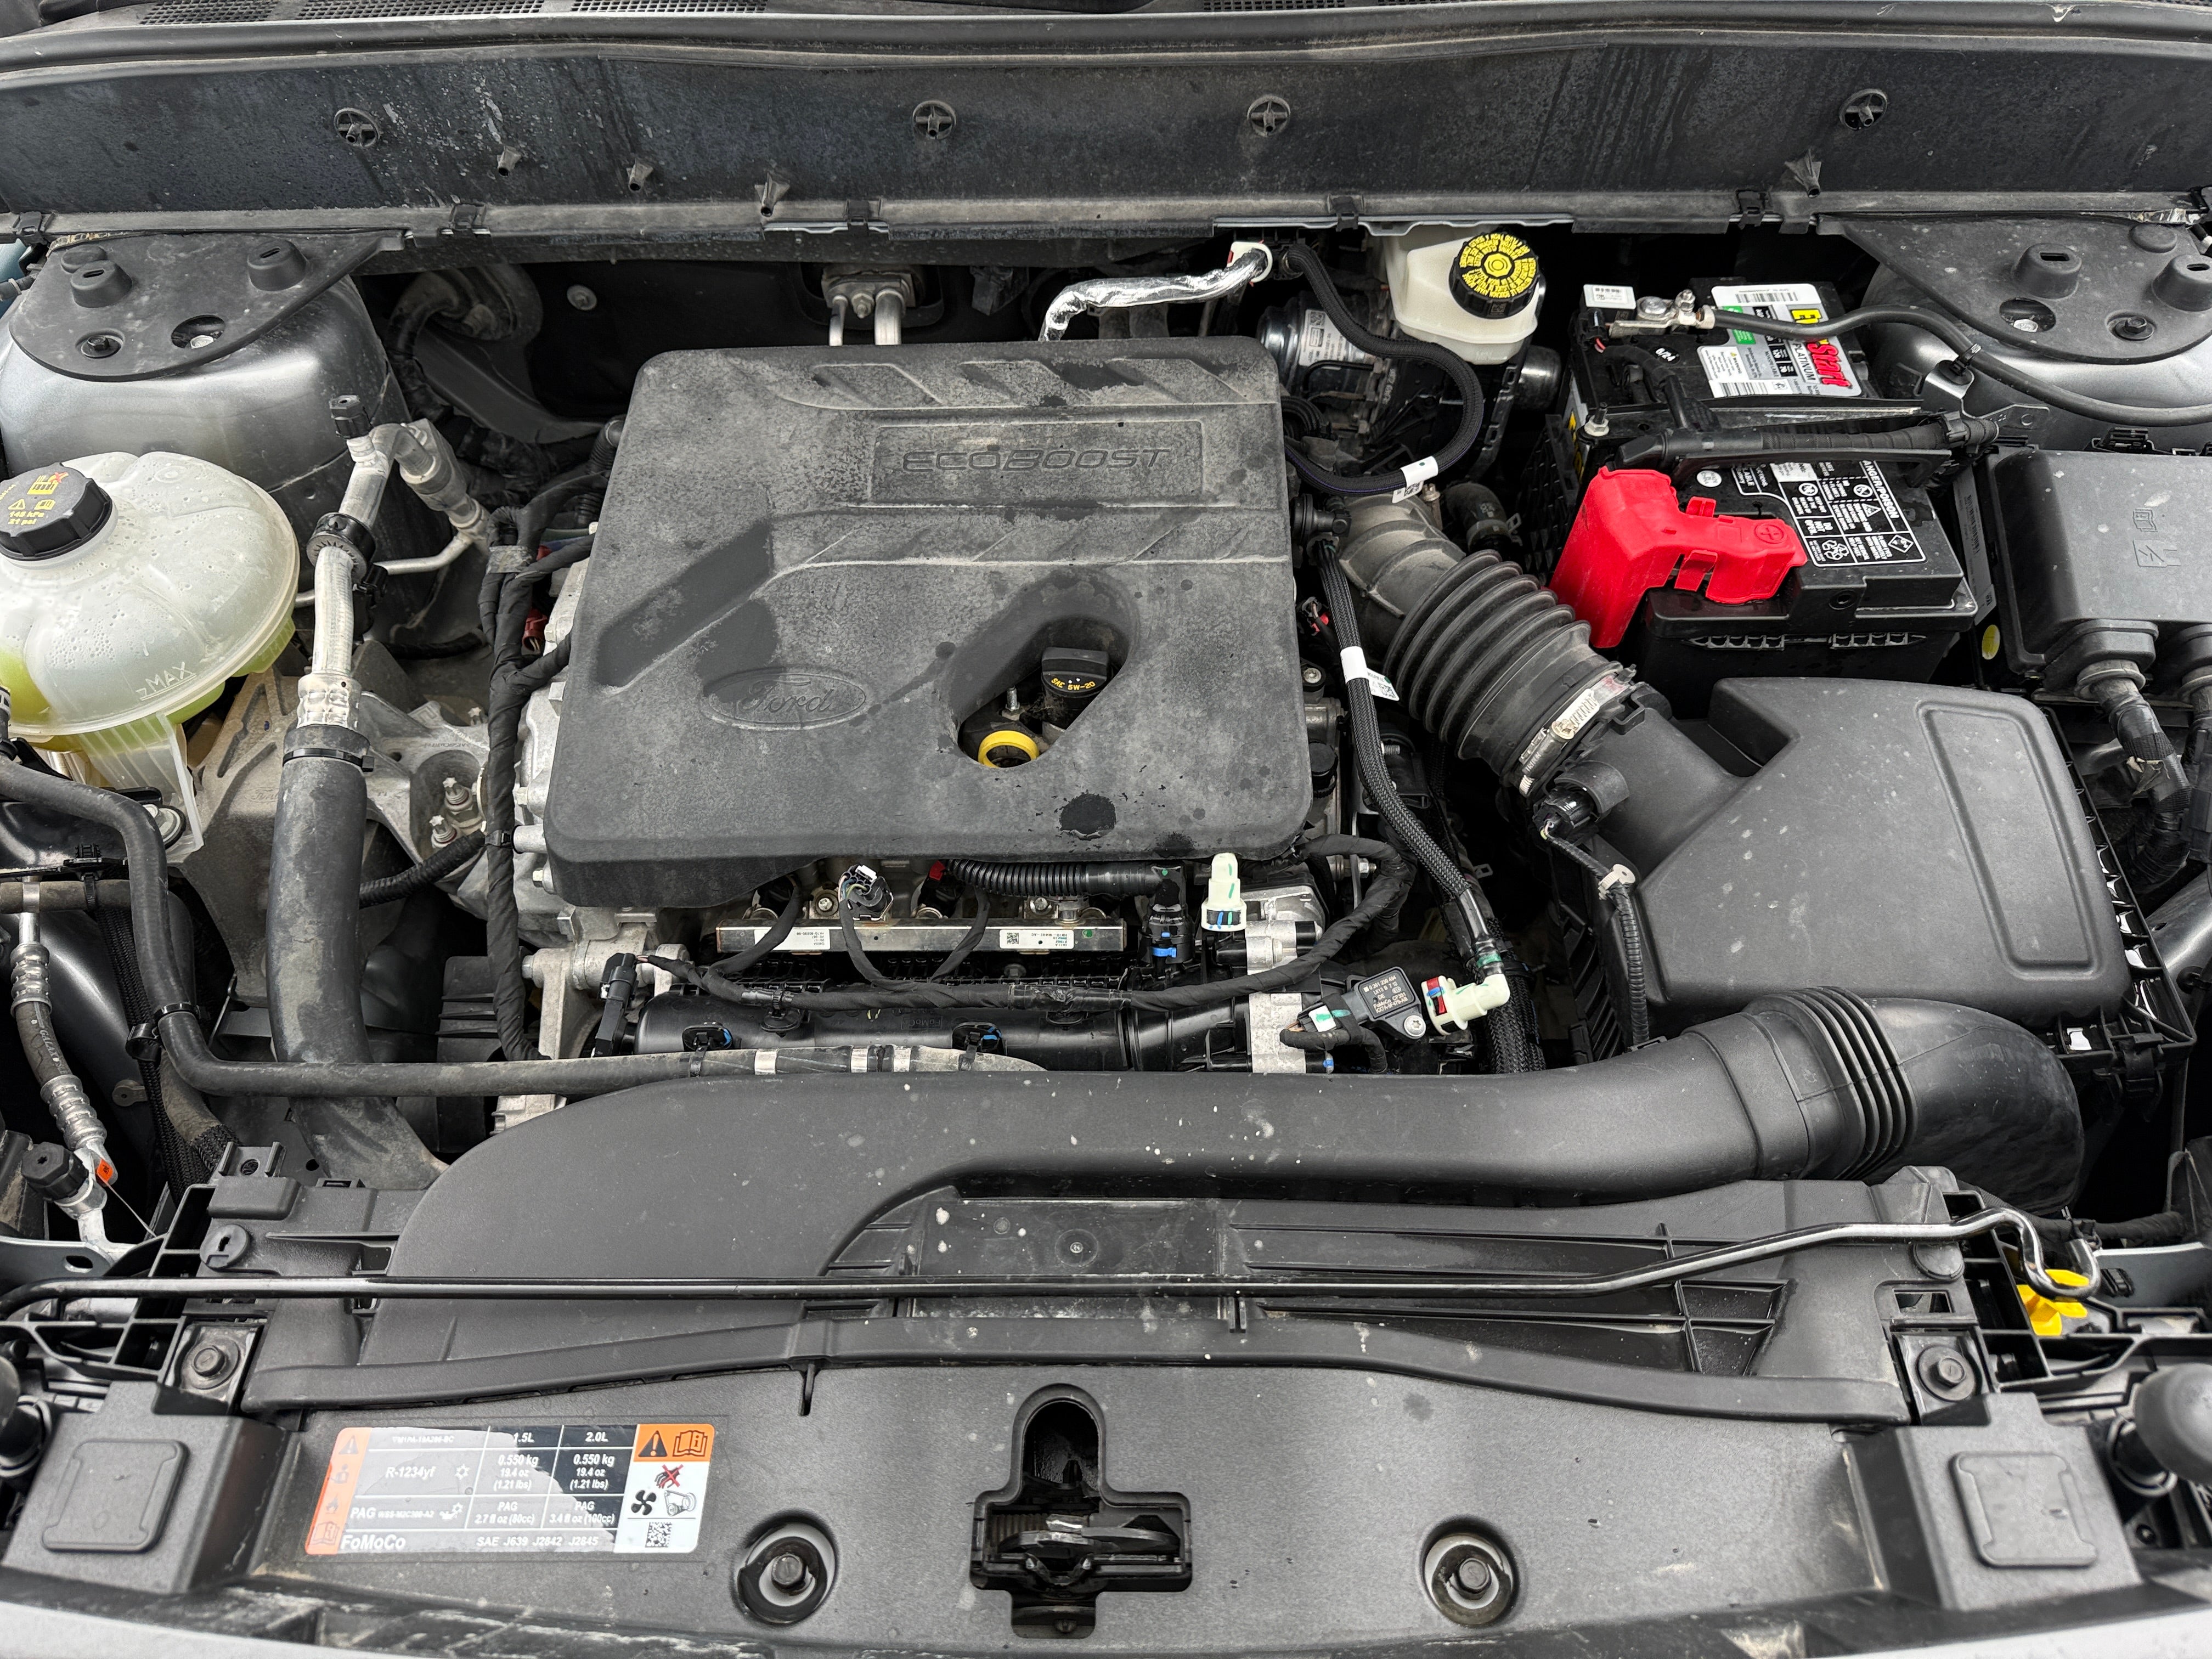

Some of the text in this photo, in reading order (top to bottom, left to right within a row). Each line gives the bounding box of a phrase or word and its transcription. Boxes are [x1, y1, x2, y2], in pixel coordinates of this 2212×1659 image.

[1791, 309, 1851, 386] EStart
[1793, 343, 1816, 381] PLATINUM
[1863, 460, 1900, 518] ANGER/POISON
[1814, 521, 1826, 533] NOT
[1822, 522, 1833, 531] DO
[145, 661, 193, 692] MAX
[1051, 678, 1096, 691] SAE 5W-20
[737, 679, 832, 713] Ford
[1373, 998, 1392, 1009] FoMoCo
[513, 1432, 535, 1442] 1.5L
[585, 1432, 609, 1442] 2.0L
[498, 1454, 539, 1468] 0.550 kg
[573, 1453, 615, 1468] 0.550 kg
[385, 1466, 437, 1480] R-1234yf
[500, 1468, 518, 1477] 19.4
[576, 1468, 594, 1476] 19.4
[493, 1479, 532, 1491] (1.21 lbs)
[569, 1479, 609, 1491] (1.21 lbs)
[497, 1502, 518, 1511] PAG
[575, 1501, 595, 1510] PAG
[350, 1507, 376, 1519] PAG
[474, 1514, 488, 1523] 2.7
[489, 1514, 496, 1523] fl
[549, 1513, 563, 1523] 3.4
[563, 1513, 571, 1523] fl
[583, 1513, 616, 1525] (100cc)
[340, 1534, 407, 1550] FoMoCo
[476, 1536, 599, 1547] SAE J639 J2842 J2845
